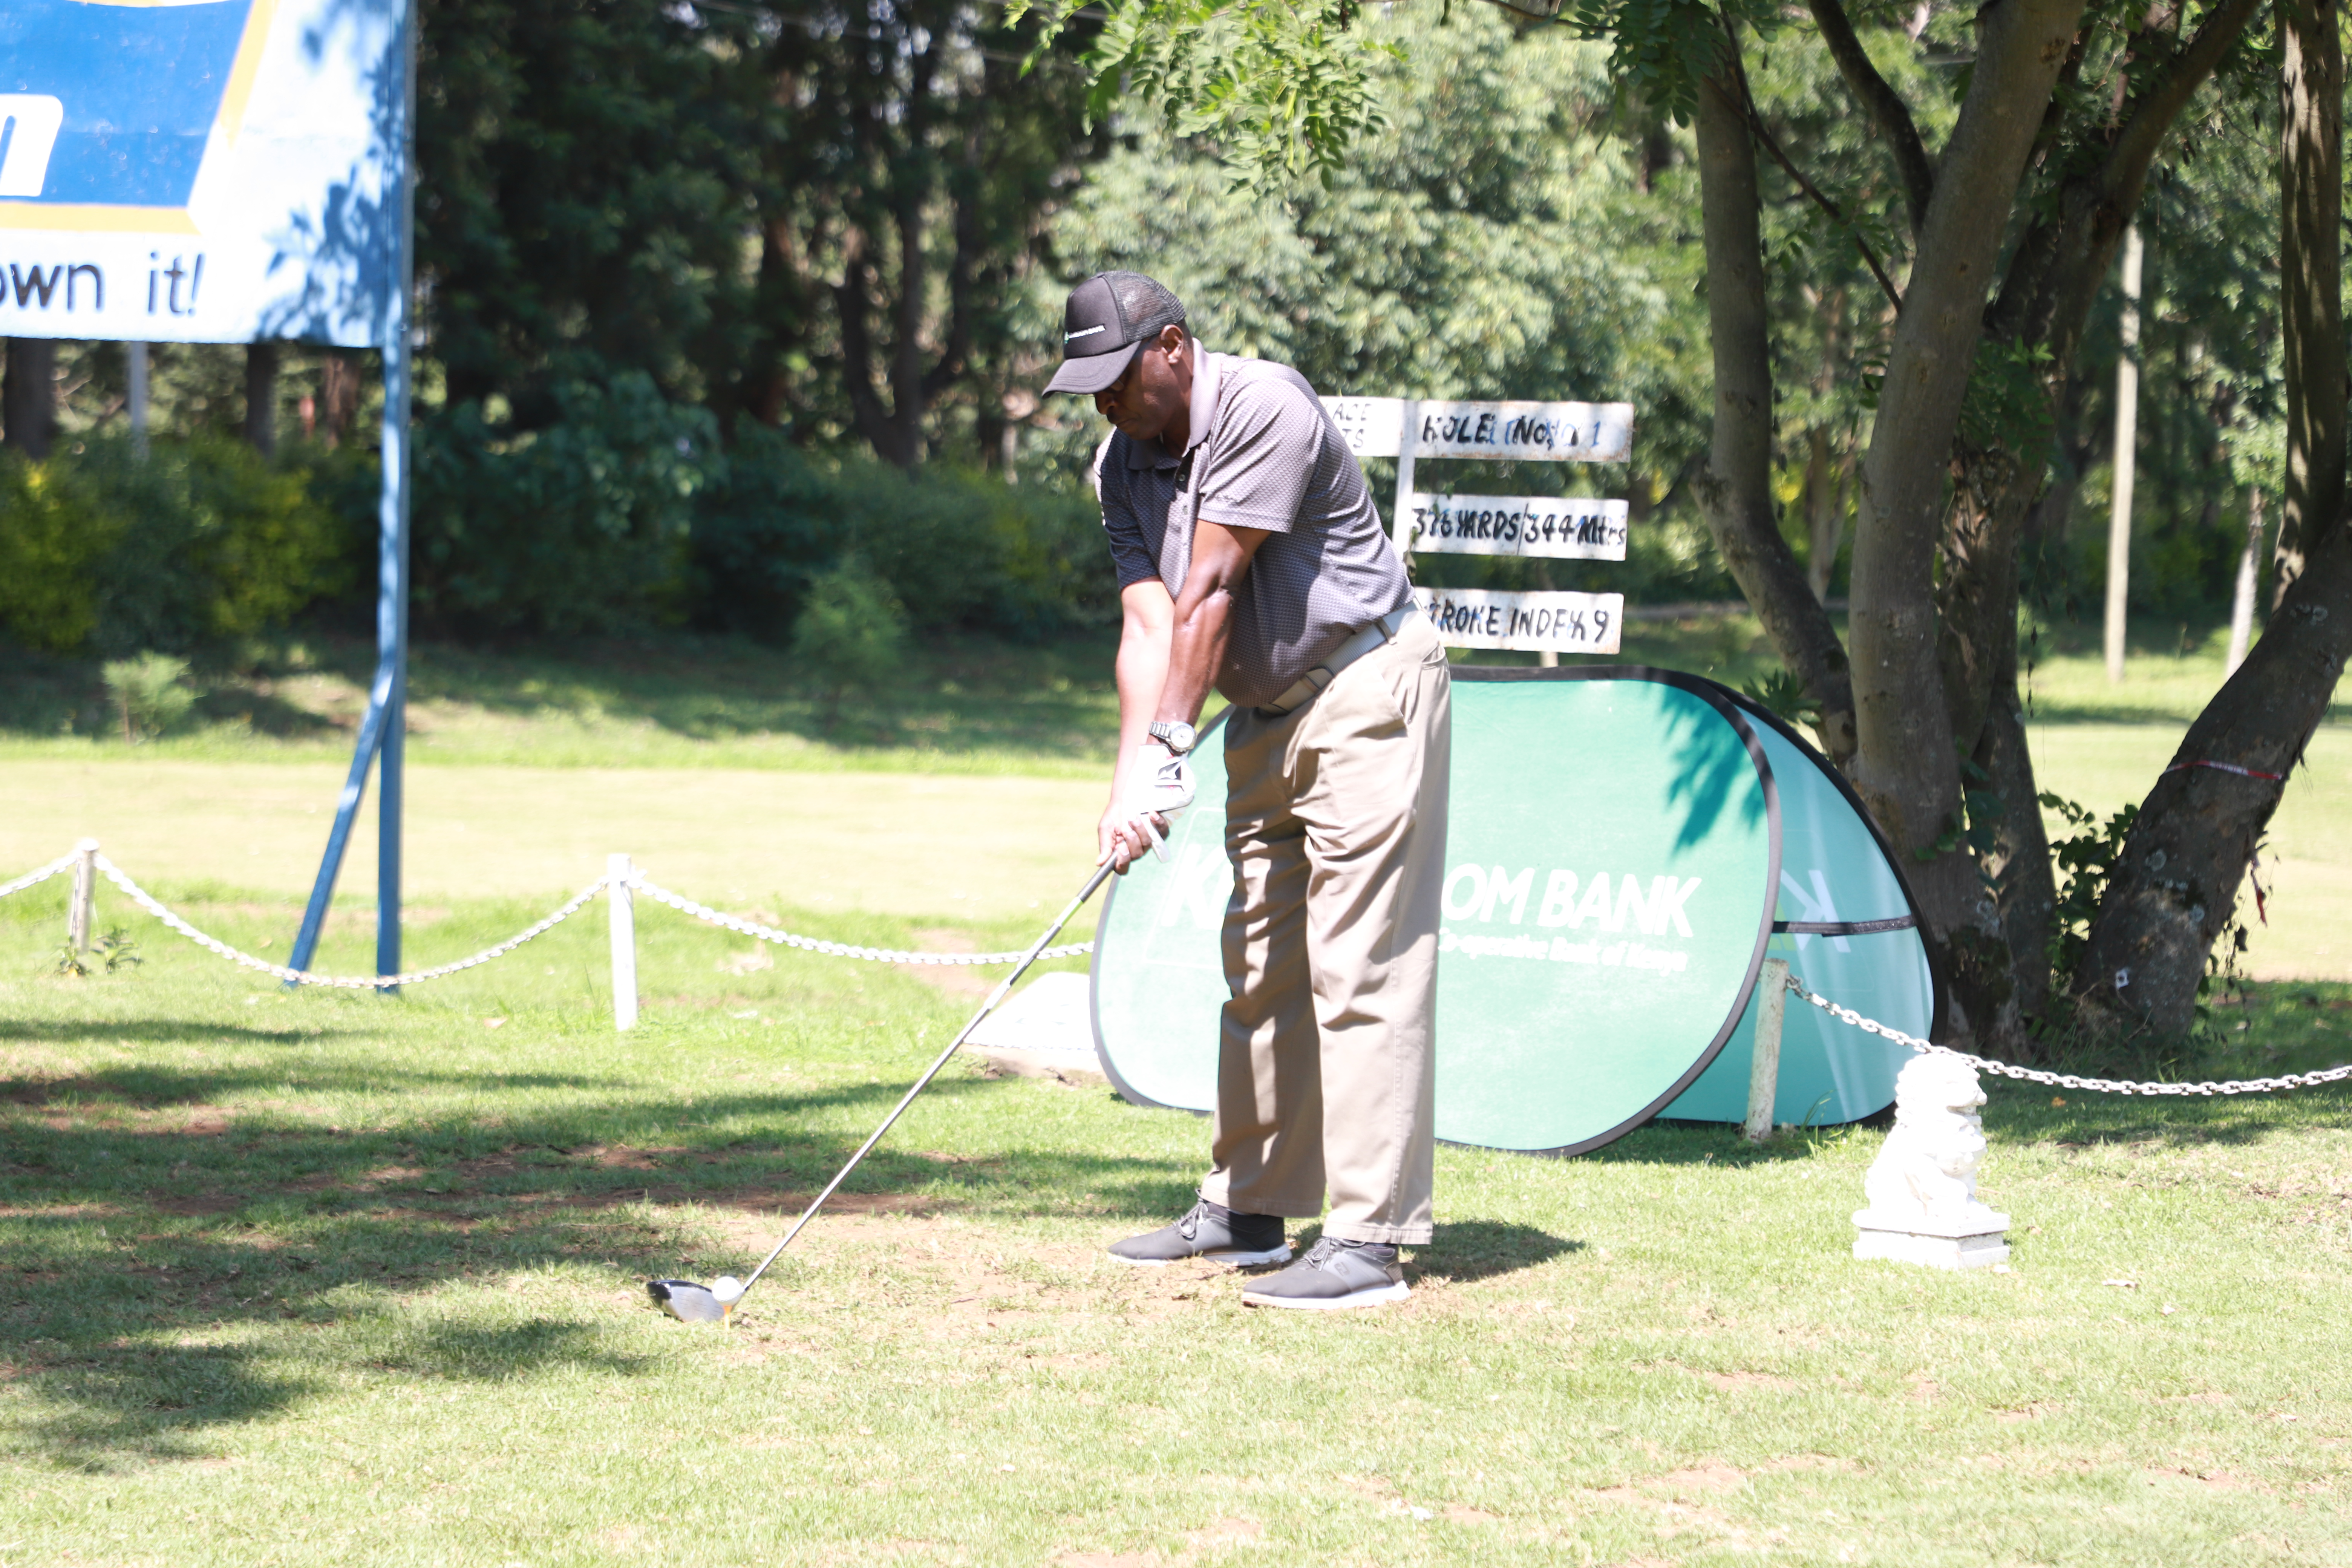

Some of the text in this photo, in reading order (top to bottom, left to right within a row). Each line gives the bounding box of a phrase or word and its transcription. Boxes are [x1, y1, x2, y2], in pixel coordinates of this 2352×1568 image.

[0, 252, 204, 314] wn it!
[1325, 403, 1372, 421] ACE
[1423, 602, 1502, 635] TROKE
[1537, 869, 1702, 937] BANK
[1549, 936, 1602, 965] Bank
